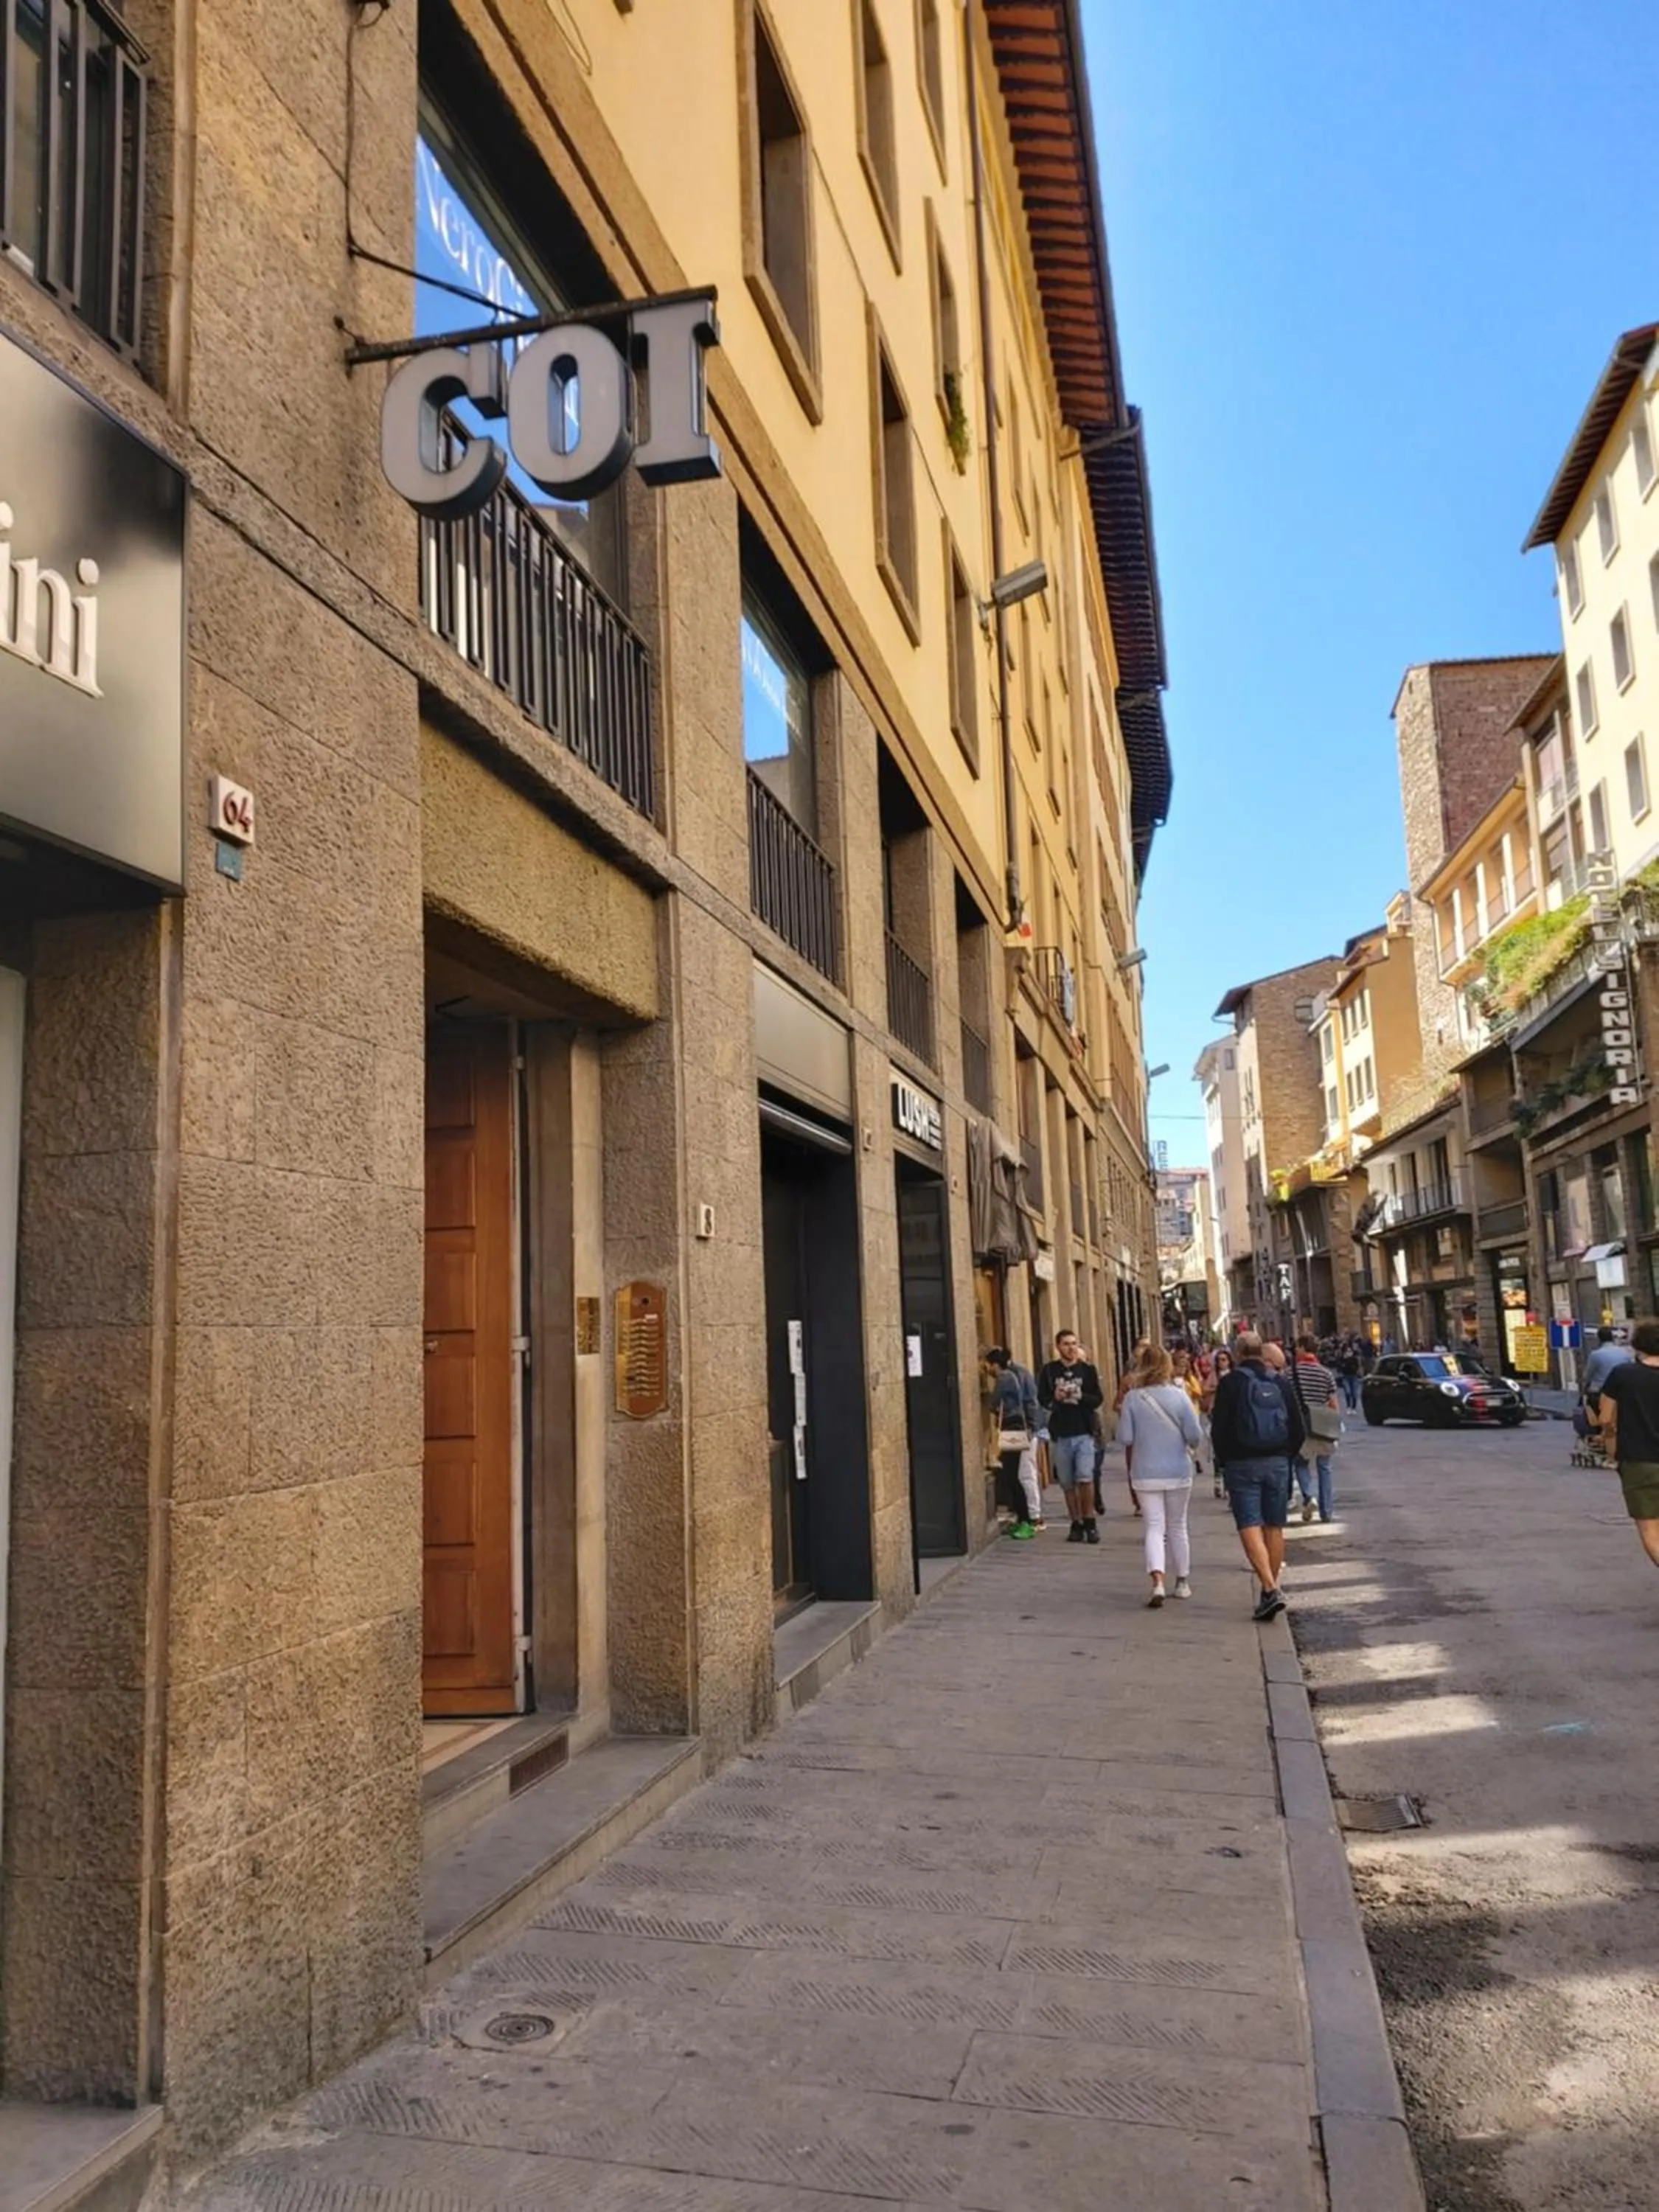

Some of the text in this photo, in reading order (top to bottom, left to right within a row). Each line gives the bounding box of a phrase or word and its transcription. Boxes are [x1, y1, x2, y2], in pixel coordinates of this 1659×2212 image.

[381, 299, 721, 520] COI
[223, 790, 252, 832] 64
[1596, 953, 1638, 1105] SIGNORIA
[897, 1083, 930, 1143] LUSH
